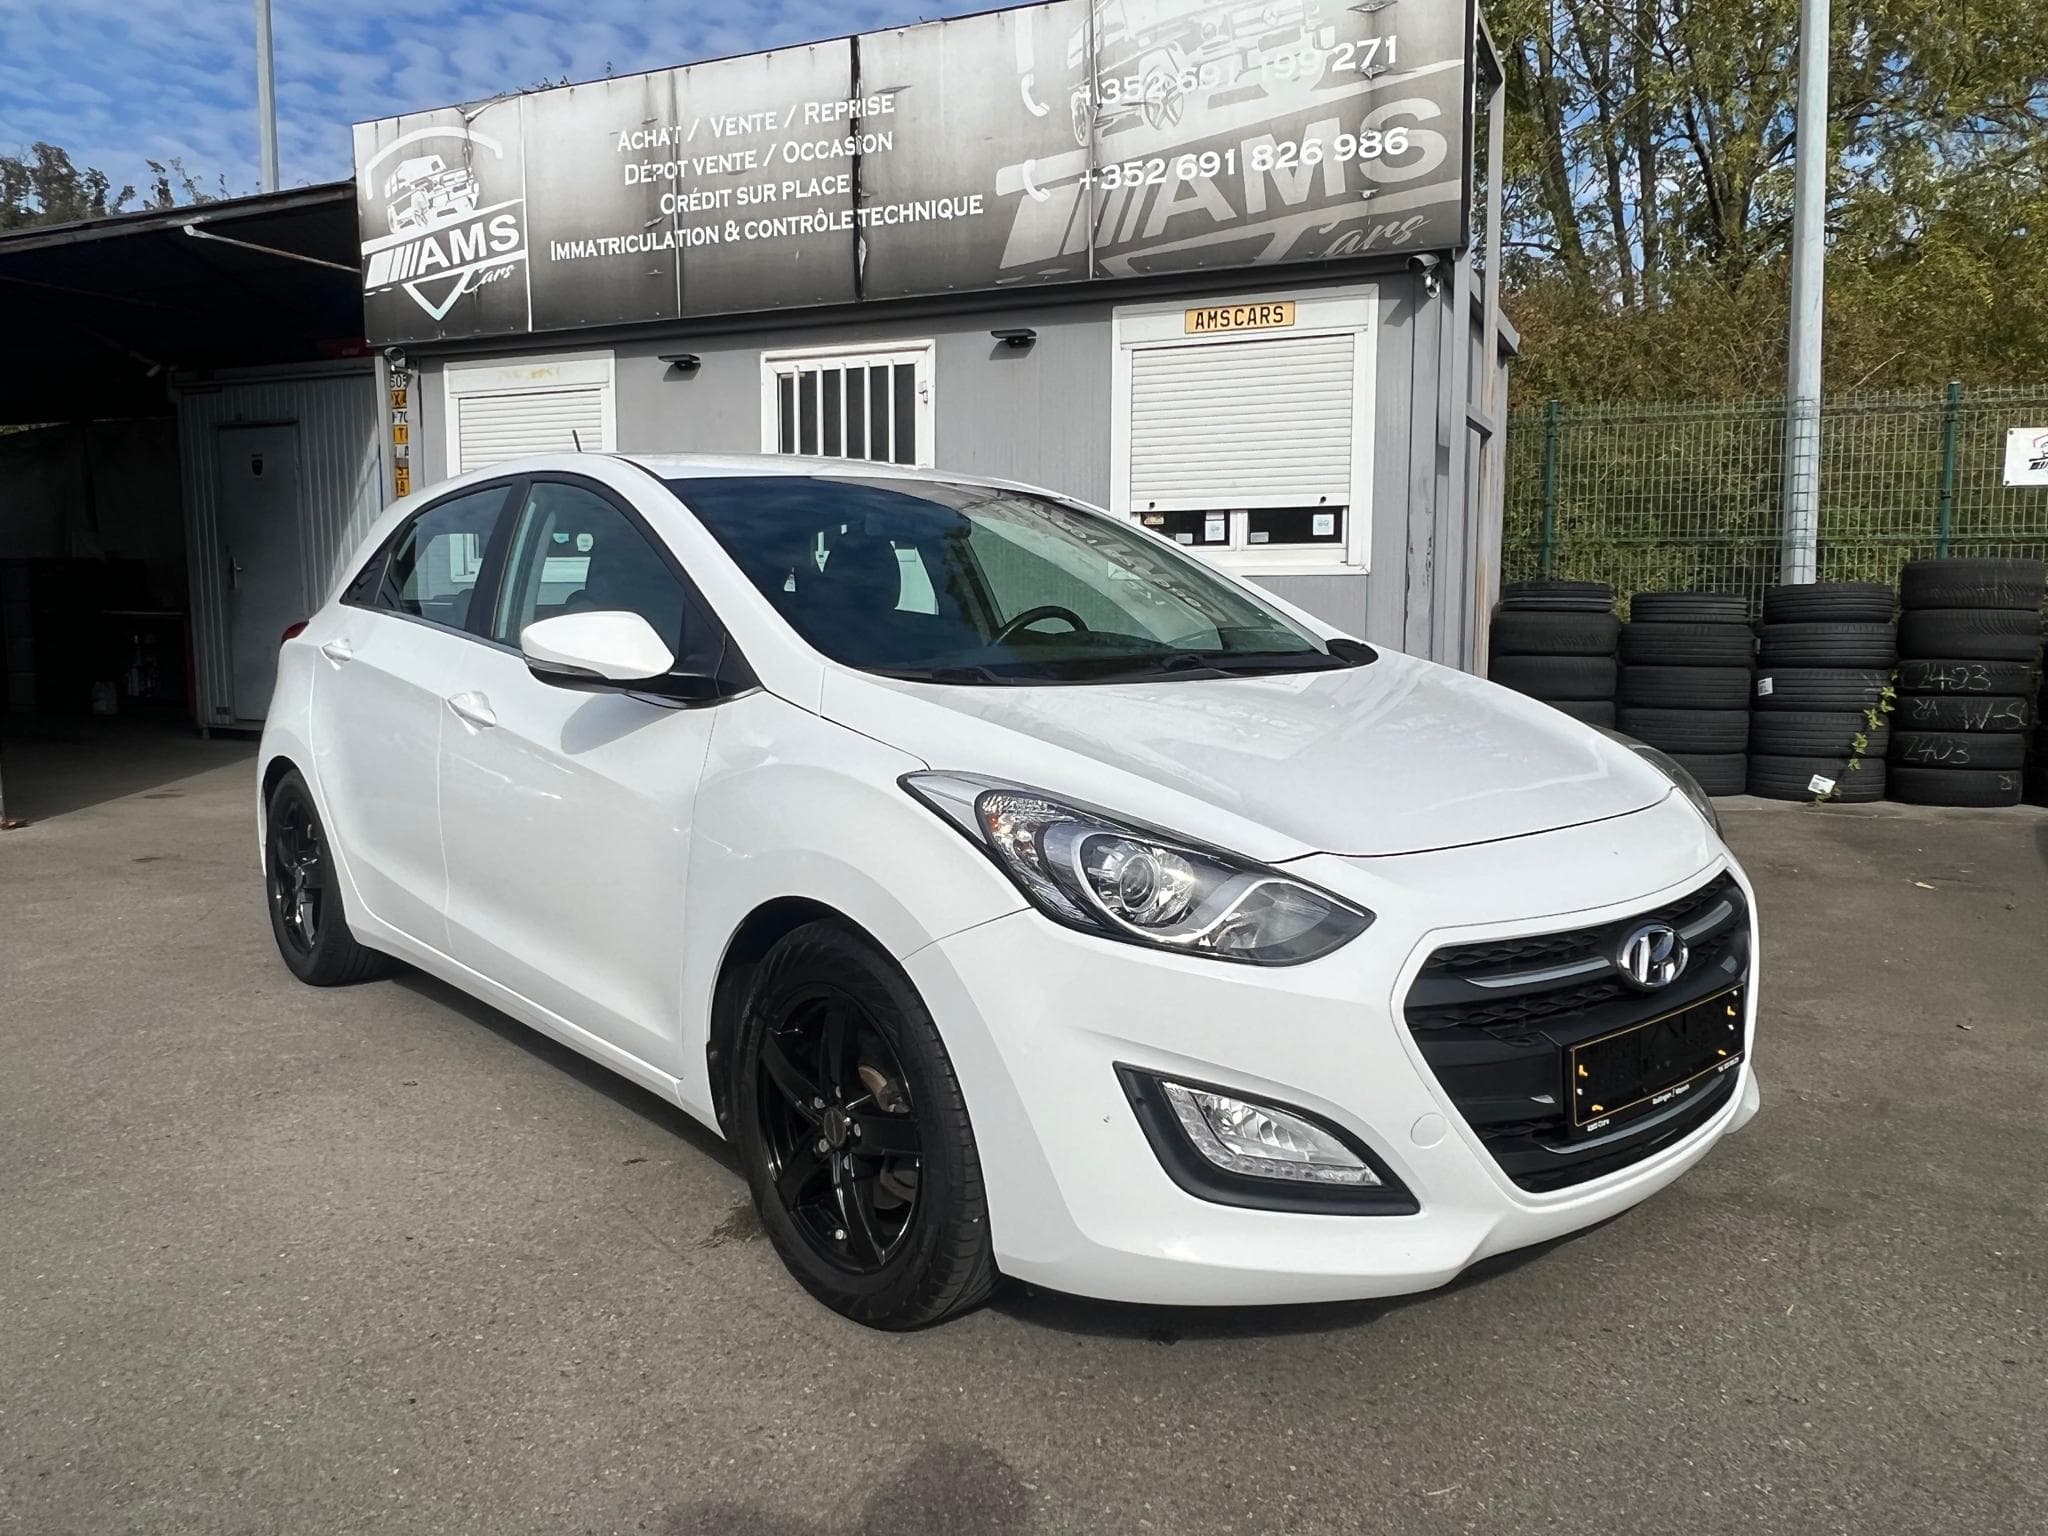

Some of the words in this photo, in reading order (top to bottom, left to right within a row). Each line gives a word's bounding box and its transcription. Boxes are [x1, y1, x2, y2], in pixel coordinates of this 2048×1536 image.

[1331, 35, 1398, 73] 271
[617, 126, 682, 152] ACHAT
[710, 112, 778, 138] VENTE
[804, 94, 895, 125] REPRISE
[692, 150, 758, 176] VENTE
[783, 131, 893, 163] OCCASION
[1079, 158, 1167, 190] +352
[1176, 149, 1235, 180] 691
[1251, 138, 1323, 171] 826
[1333, 127, 1409, 161] 986
[736, 184, 777, 206] SUR
[782, 174, 850, 200] PLACE
[416, 214, 520, 276] AMS
[550, 225, 720, 261] IMMATRICULATION
[744, 207, 854, 241] CONTRÔLE
[857, 194, 984, 229] TECHNIQUE
[1195, 305, 1284, 330] AMSCARS
